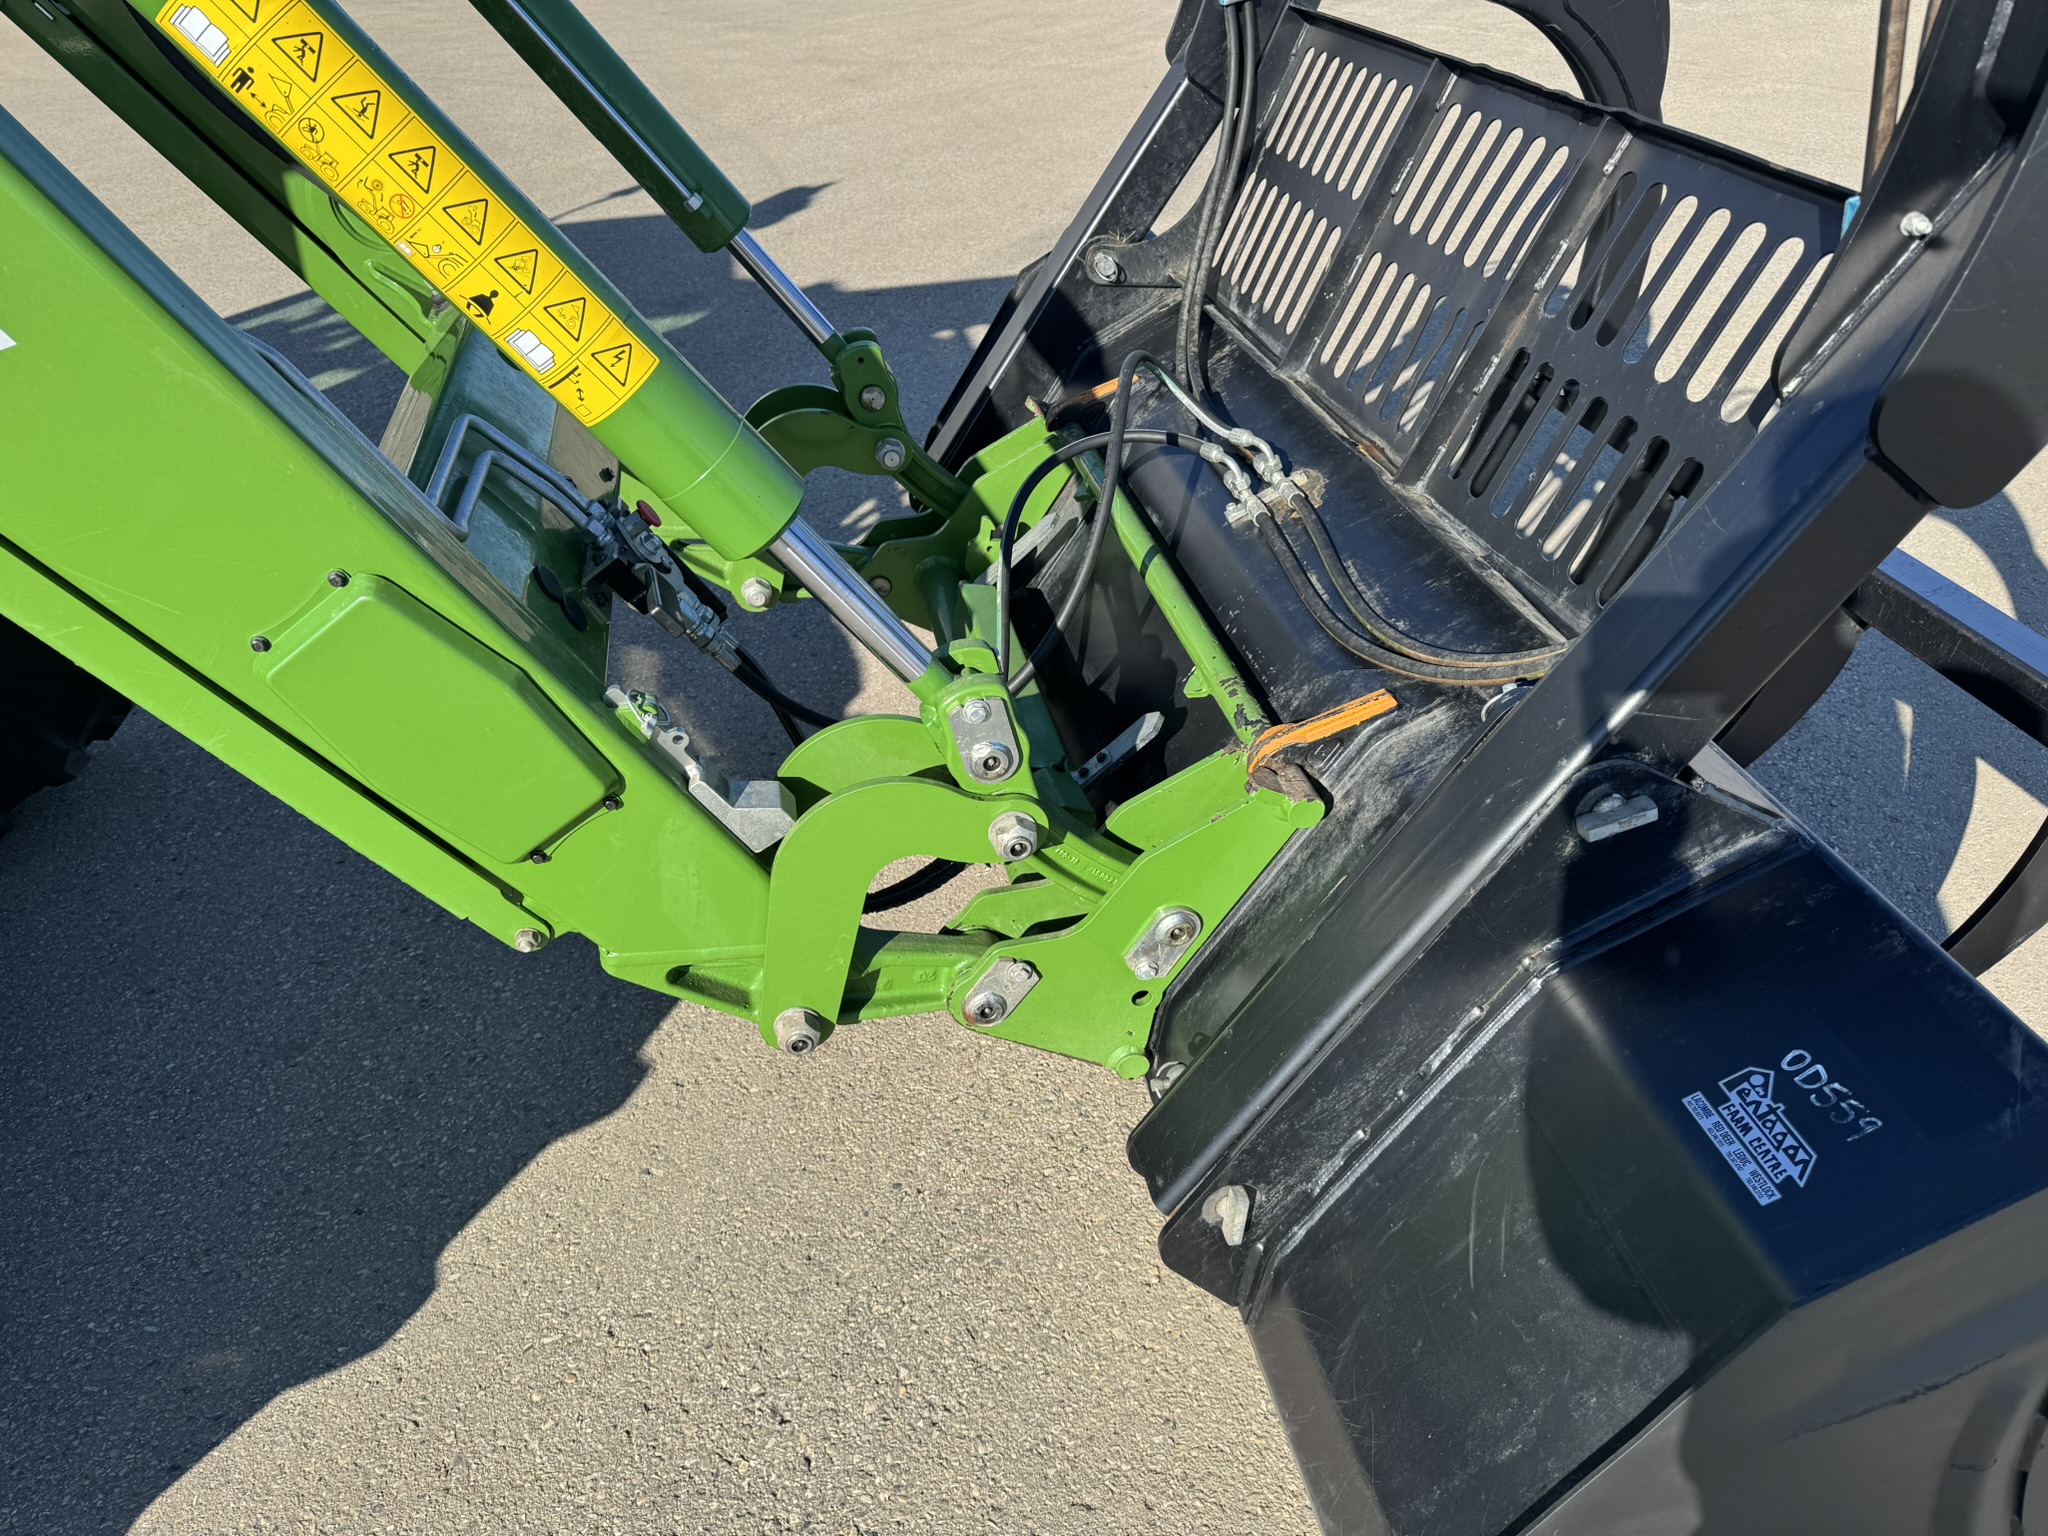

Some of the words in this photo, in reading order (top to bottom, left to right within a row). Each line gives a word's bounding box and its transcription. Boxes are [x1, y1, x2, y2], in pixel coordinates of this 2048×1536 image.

[1690, 1094, 1714, 1119] LACOMBE
[1711, 1121, 1724, 1135] RED
[1720, 1130, 1736, 1147] DEER
[1732, 1148, 1752, 1167] LEDUC
[1749, 1169, 1778, 1200] WESTLOCK
[1721, 1104, 1753, 1138] FARM
